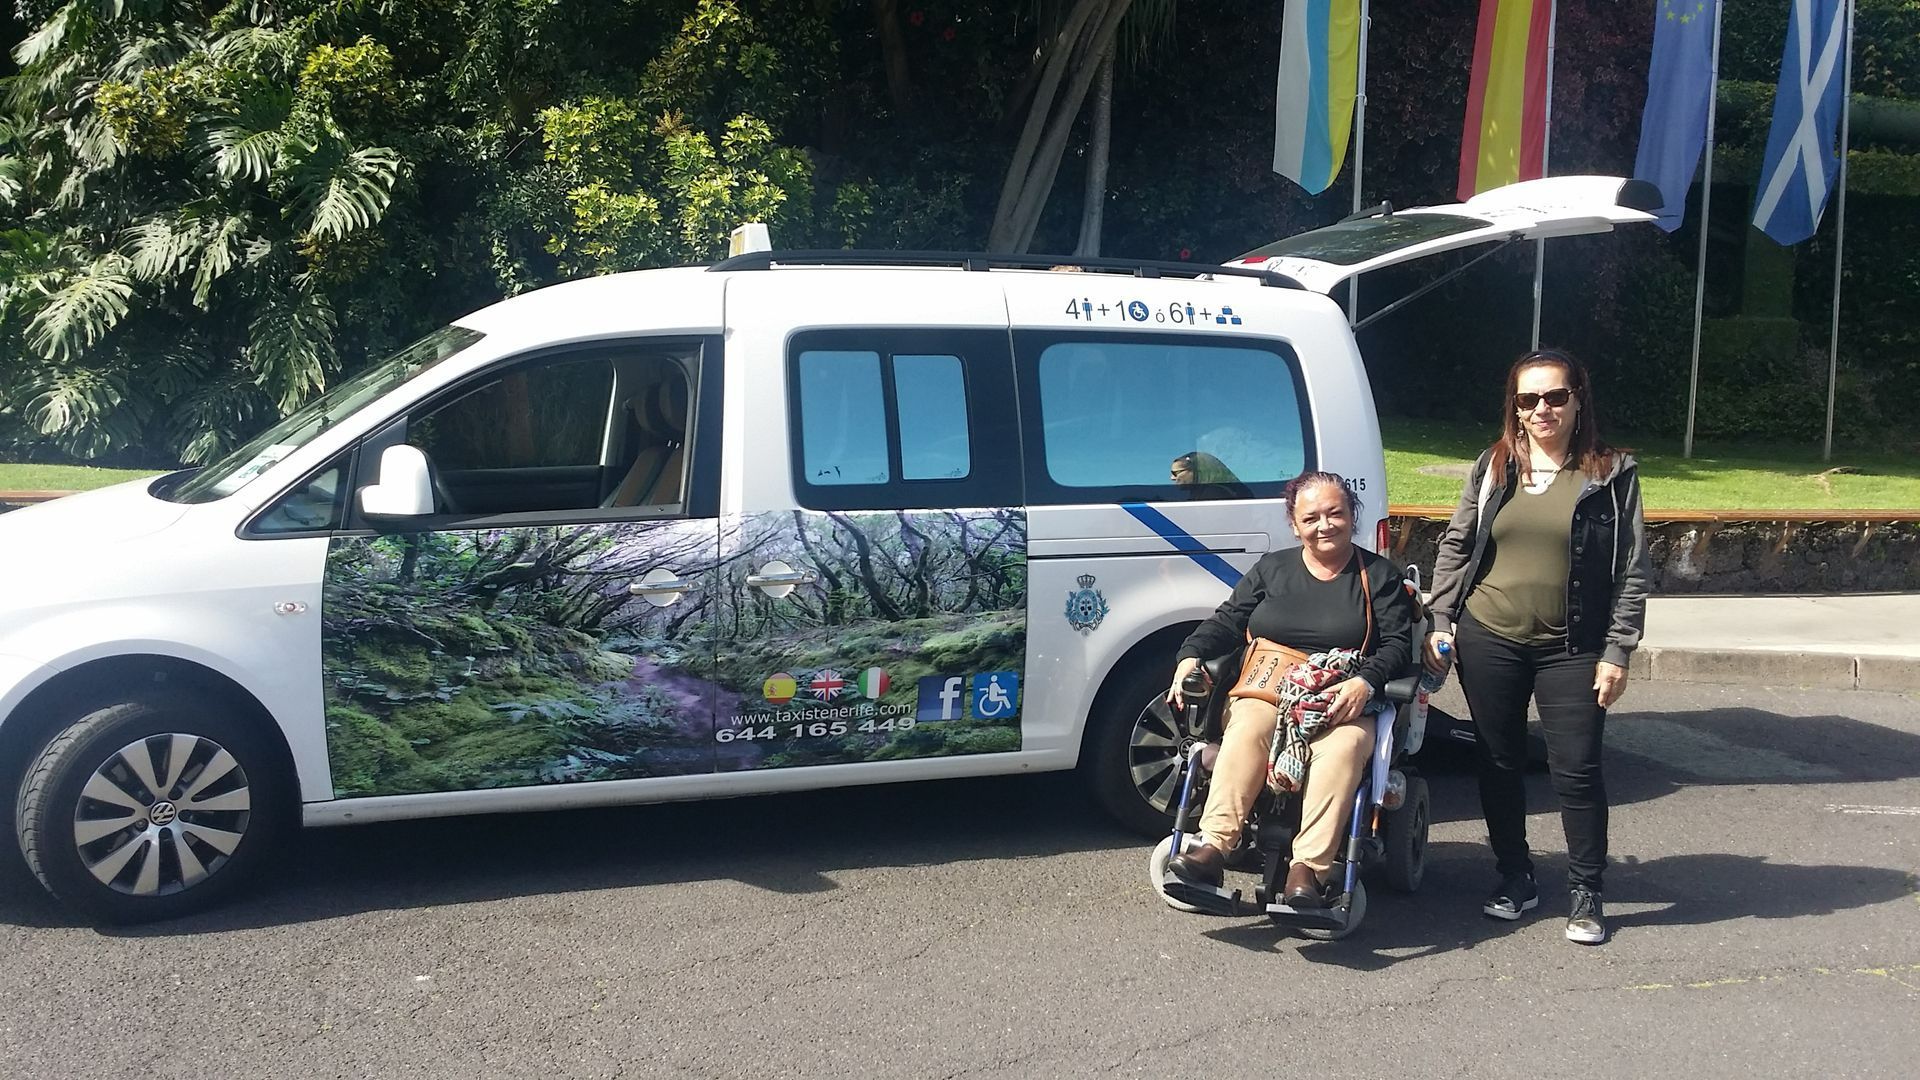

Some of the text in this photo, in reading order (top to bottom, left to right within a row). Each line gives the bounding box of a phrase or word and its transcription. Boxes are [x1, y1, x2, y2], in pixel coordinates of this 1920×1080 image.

[1065, 298, 1081, 320] 4
[1169, 302, 1184, 324] 6
[730, 702, 911, 726] www.taxistenerife.com
[715, 717, 916, 743] 644 165 449
